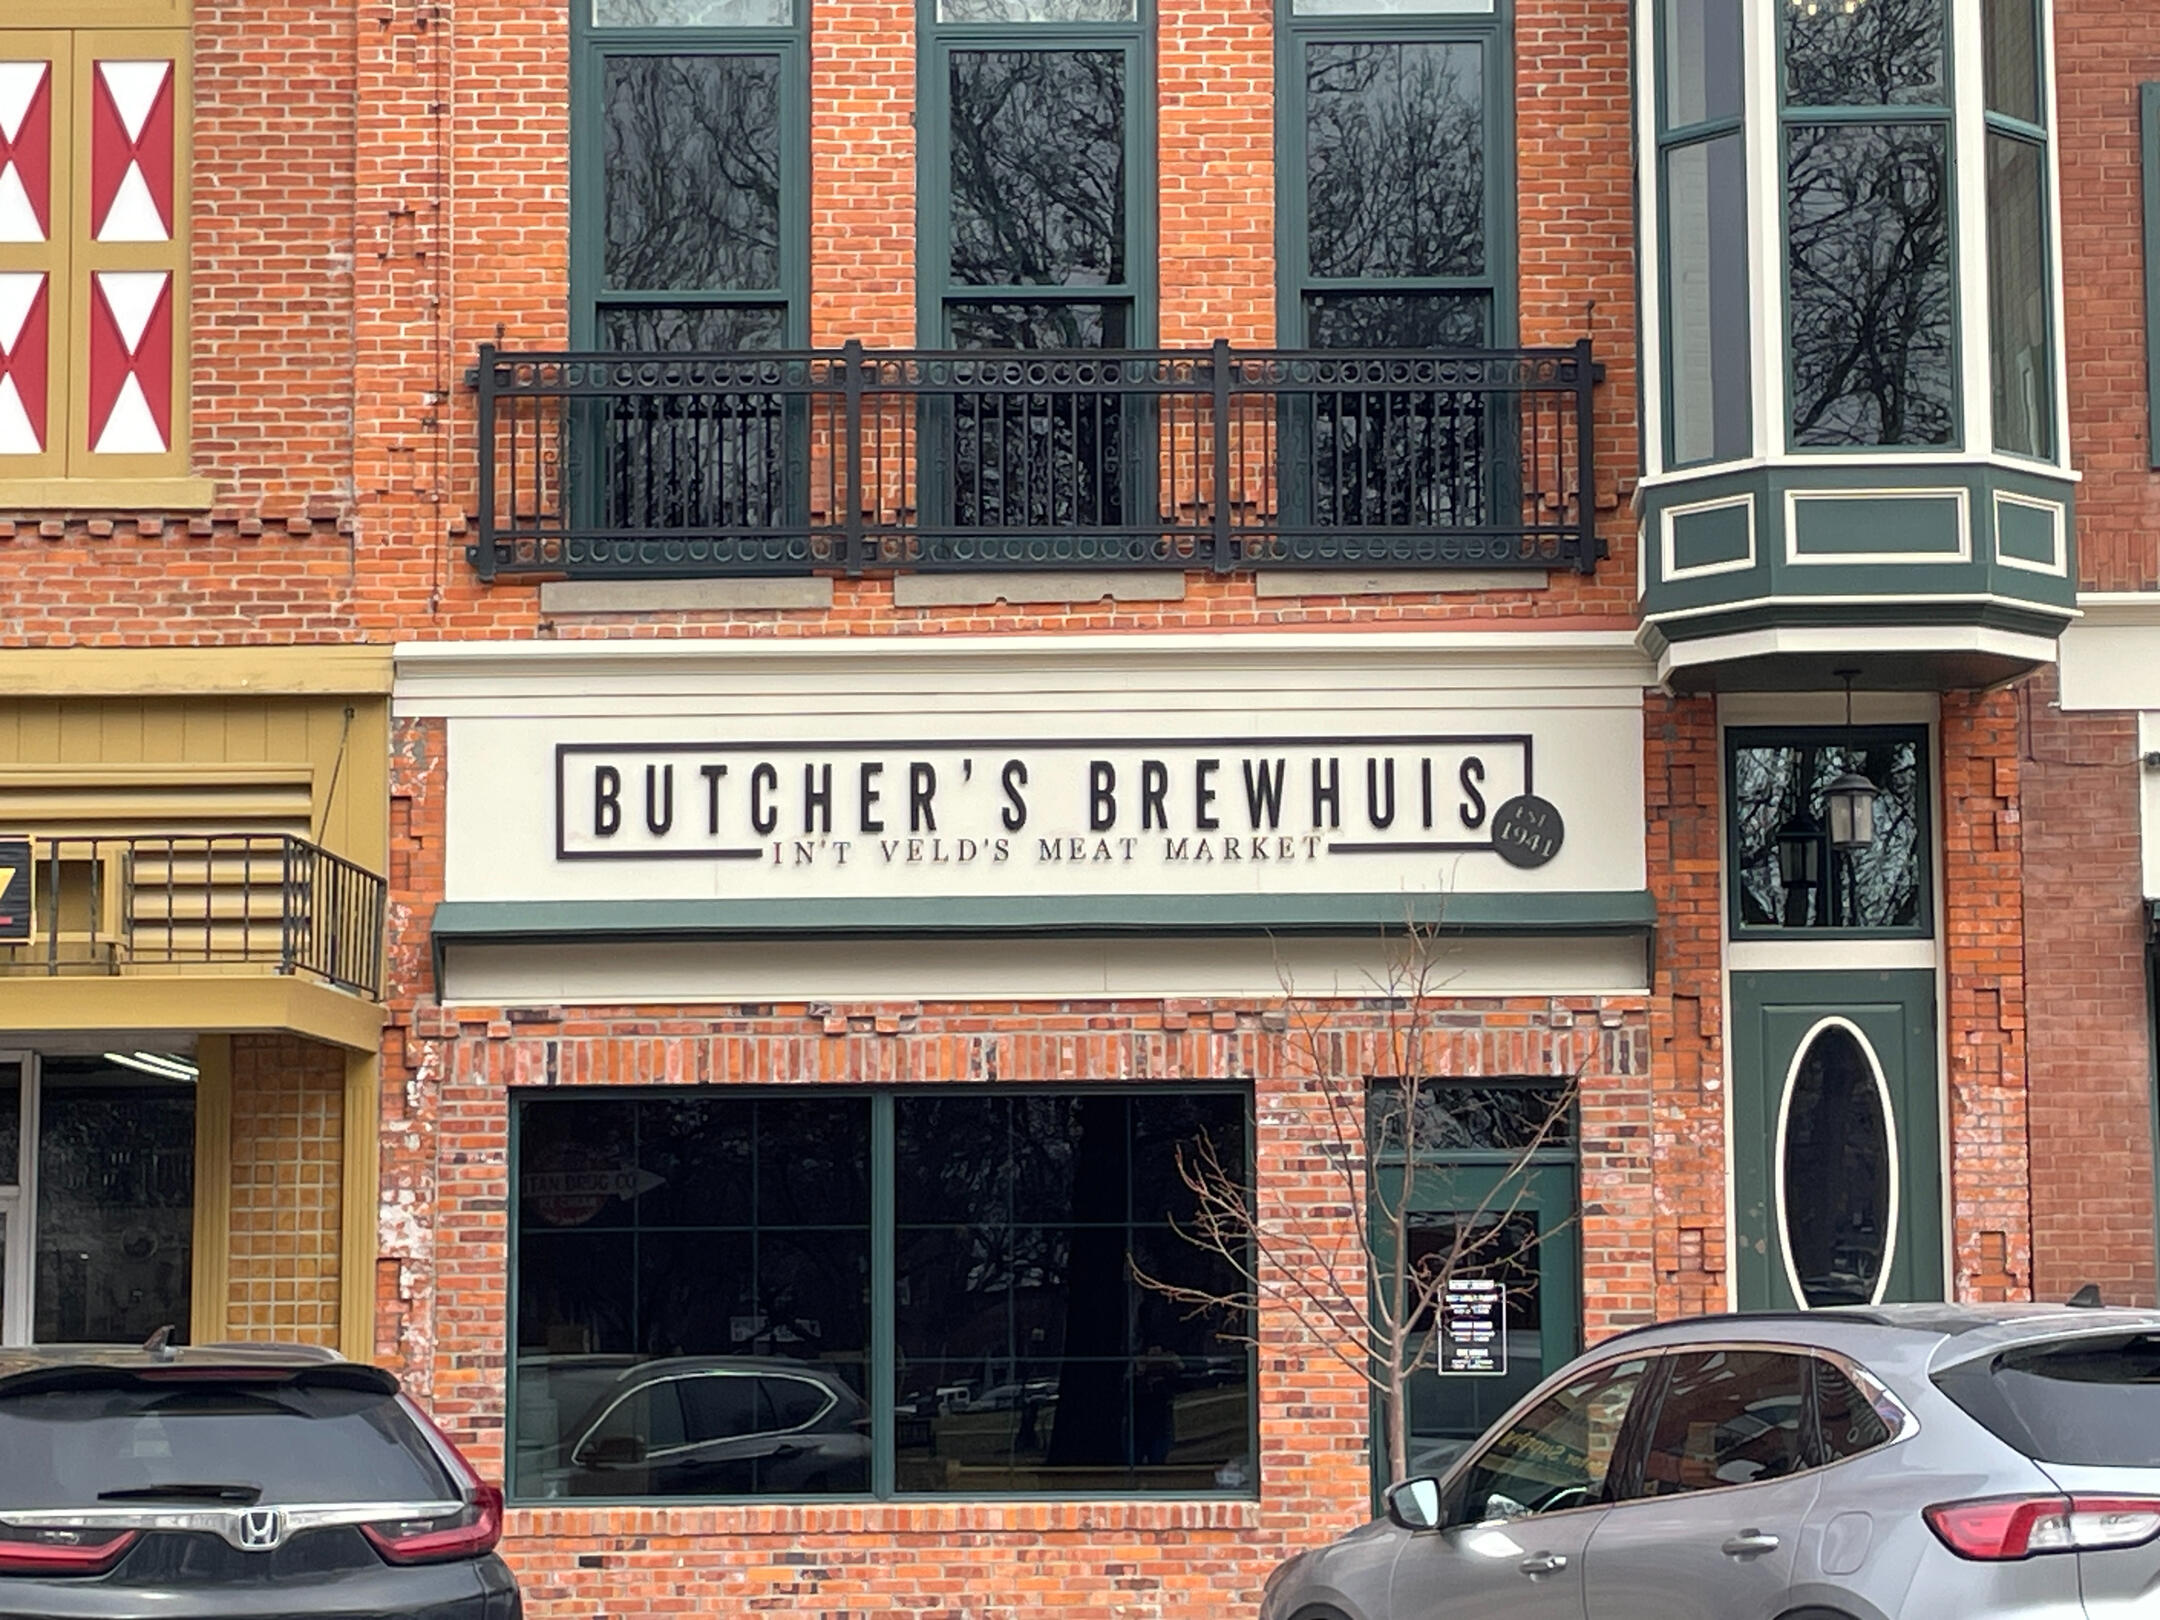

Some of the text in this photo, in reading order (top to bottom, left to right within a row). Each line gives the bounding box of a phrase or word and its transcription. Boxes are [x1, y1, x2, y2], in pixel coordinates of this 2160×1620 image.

[594, 756, 1487, 836] BUTCHER'S BREWHUIS
[773, 835, 1322, 865] IN'T VELD'S MEAT MARKET
[1501, 821, 1553, 856] 1941
